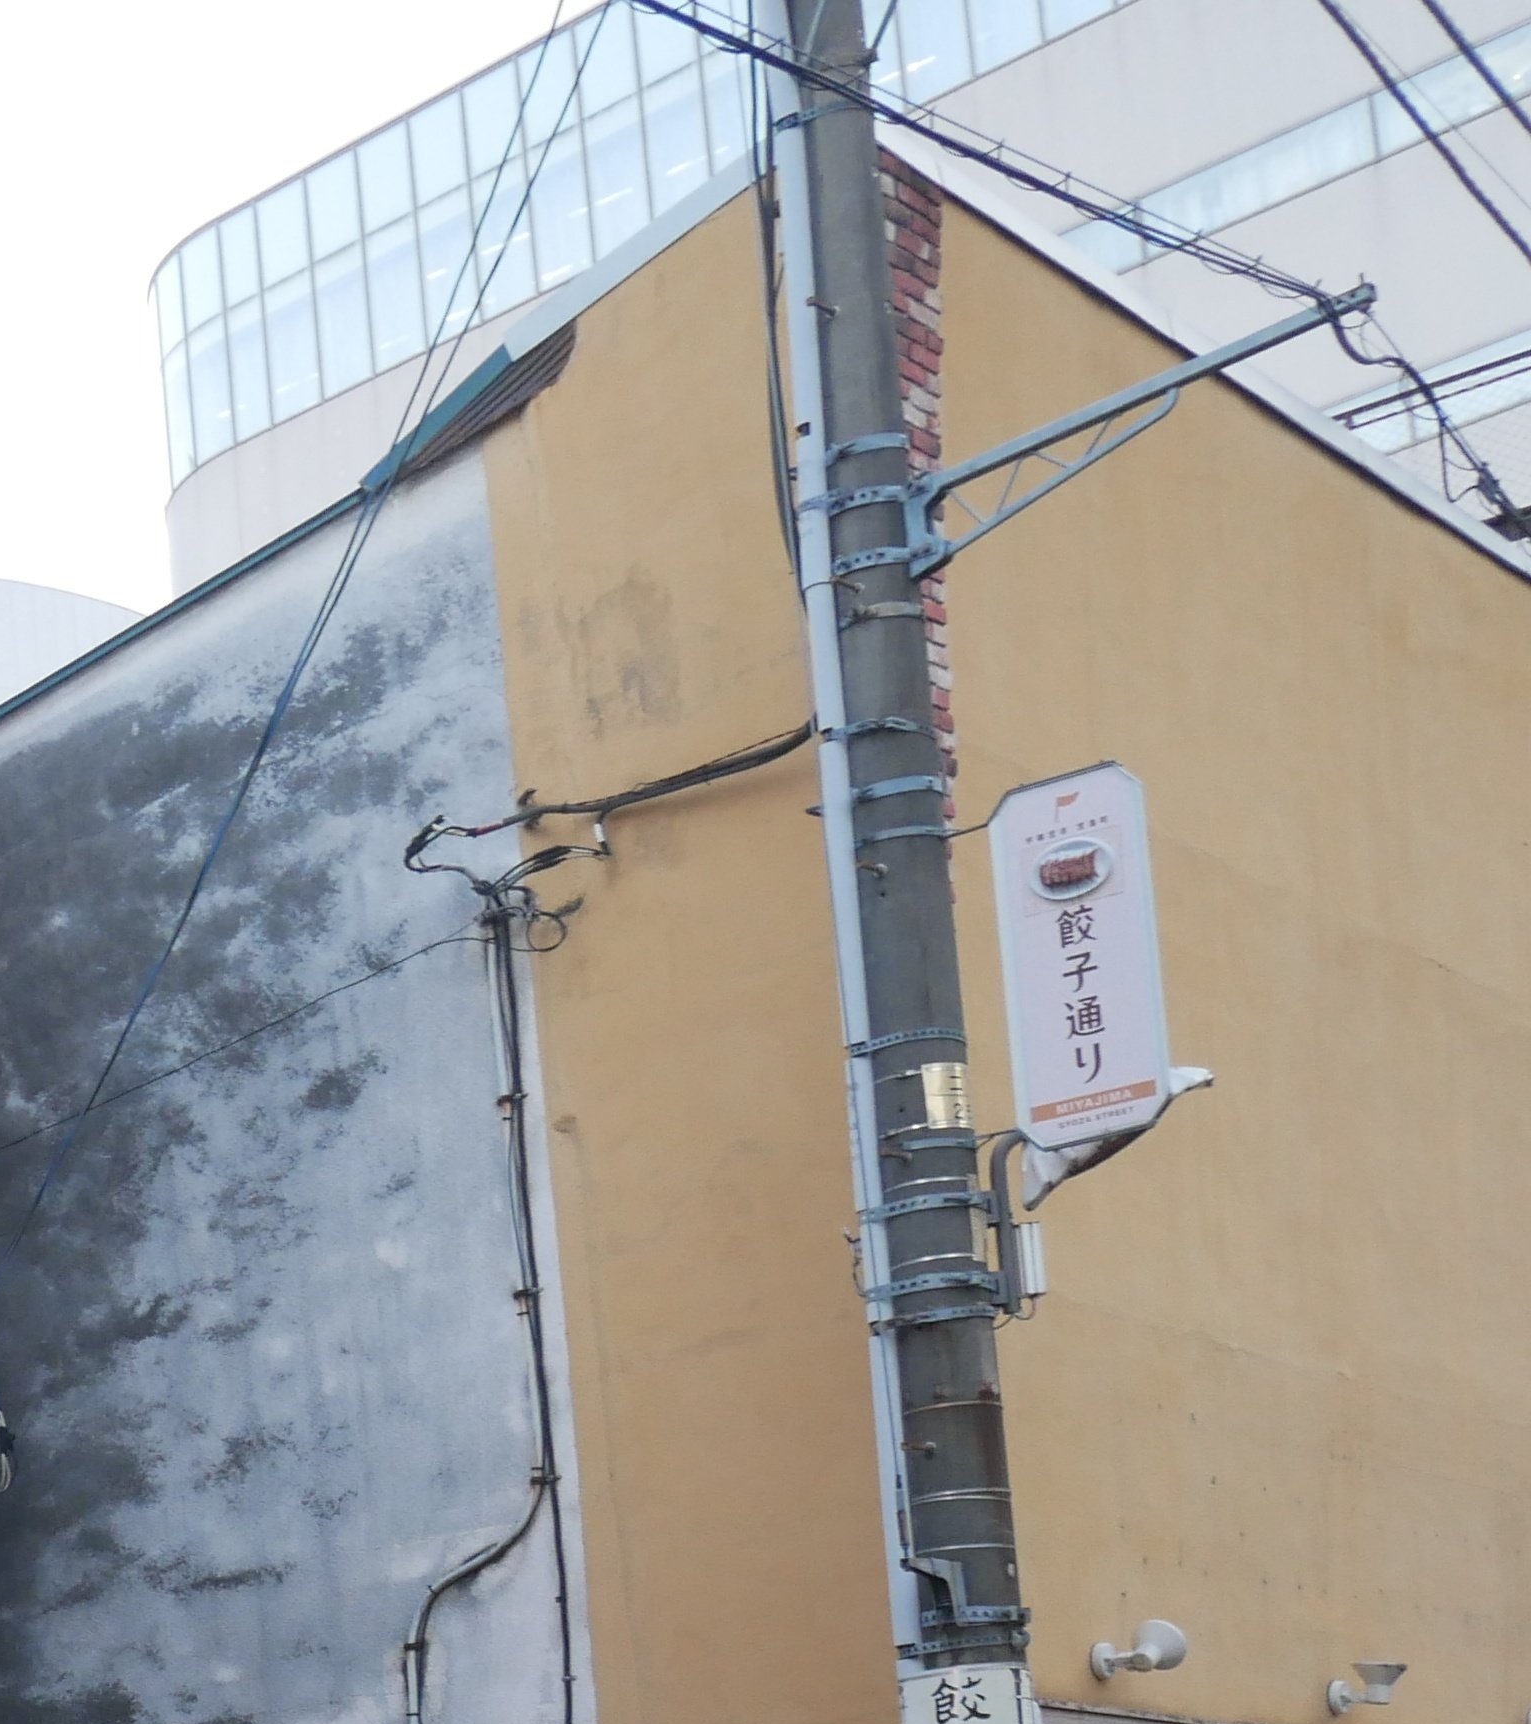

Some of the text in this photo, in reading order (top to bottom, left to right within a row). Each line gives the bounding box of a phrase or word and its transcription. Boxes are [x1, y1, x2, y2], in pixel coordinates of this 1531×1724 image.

[1056, 905, 1106, 1084] 餃子通り
[1056, 1089, 1133, 1115] MIYAJIMA
